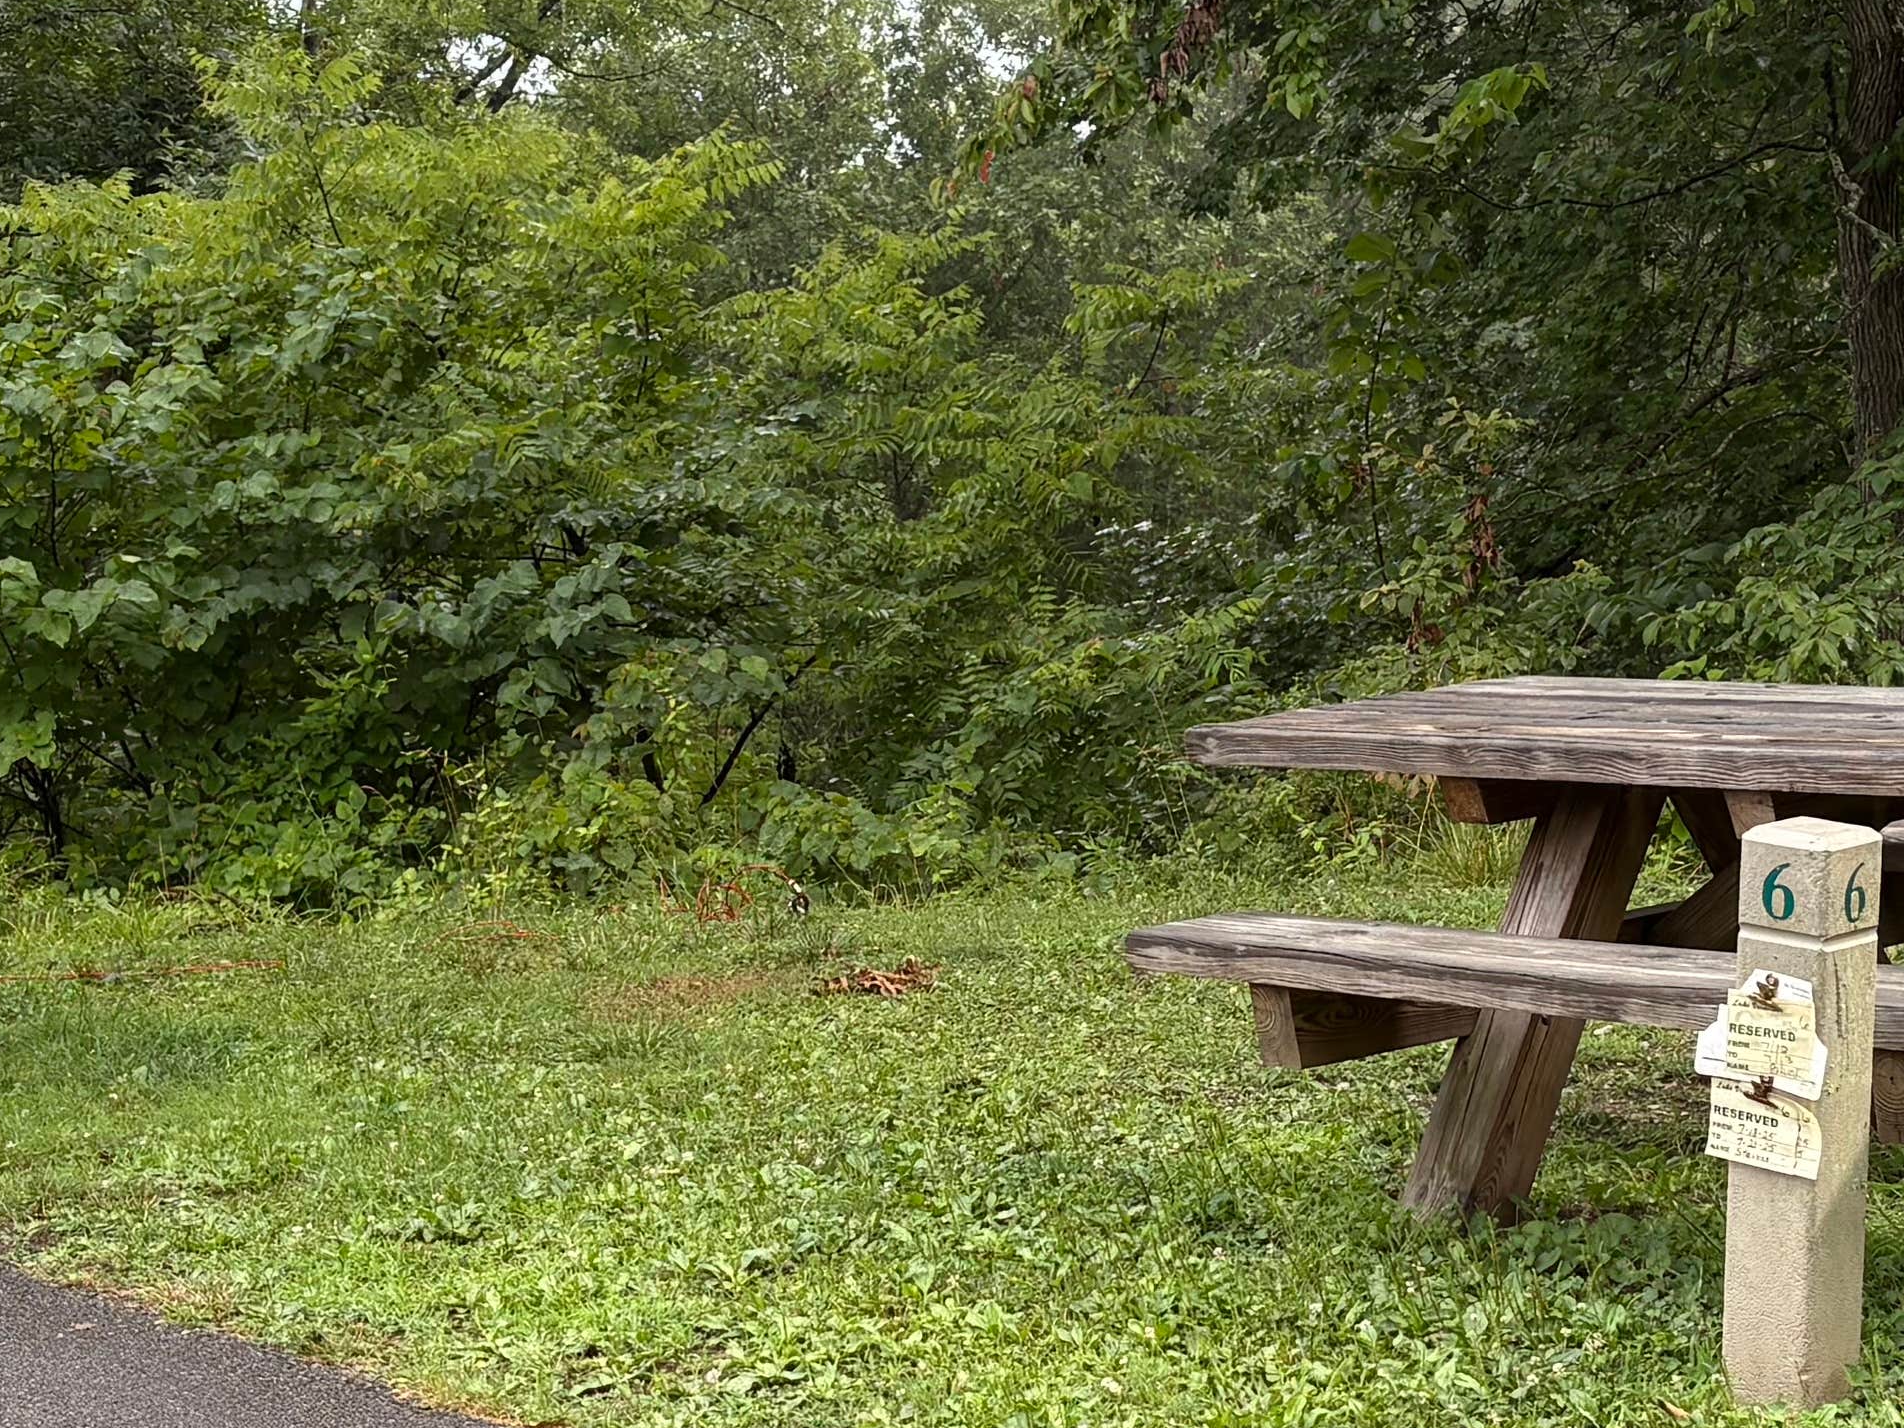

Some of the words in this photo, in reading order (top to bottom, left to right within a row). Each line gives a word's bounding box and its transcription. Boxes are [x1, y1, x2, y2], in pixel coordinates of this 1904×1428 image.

[1762, 862, 1795, 922] 6
[1844, 862, 1865, 923] 6
[1729, 1023, 1796, 1042] RESERVED
[1714, 1104, 1779, 1128] RESERVED
